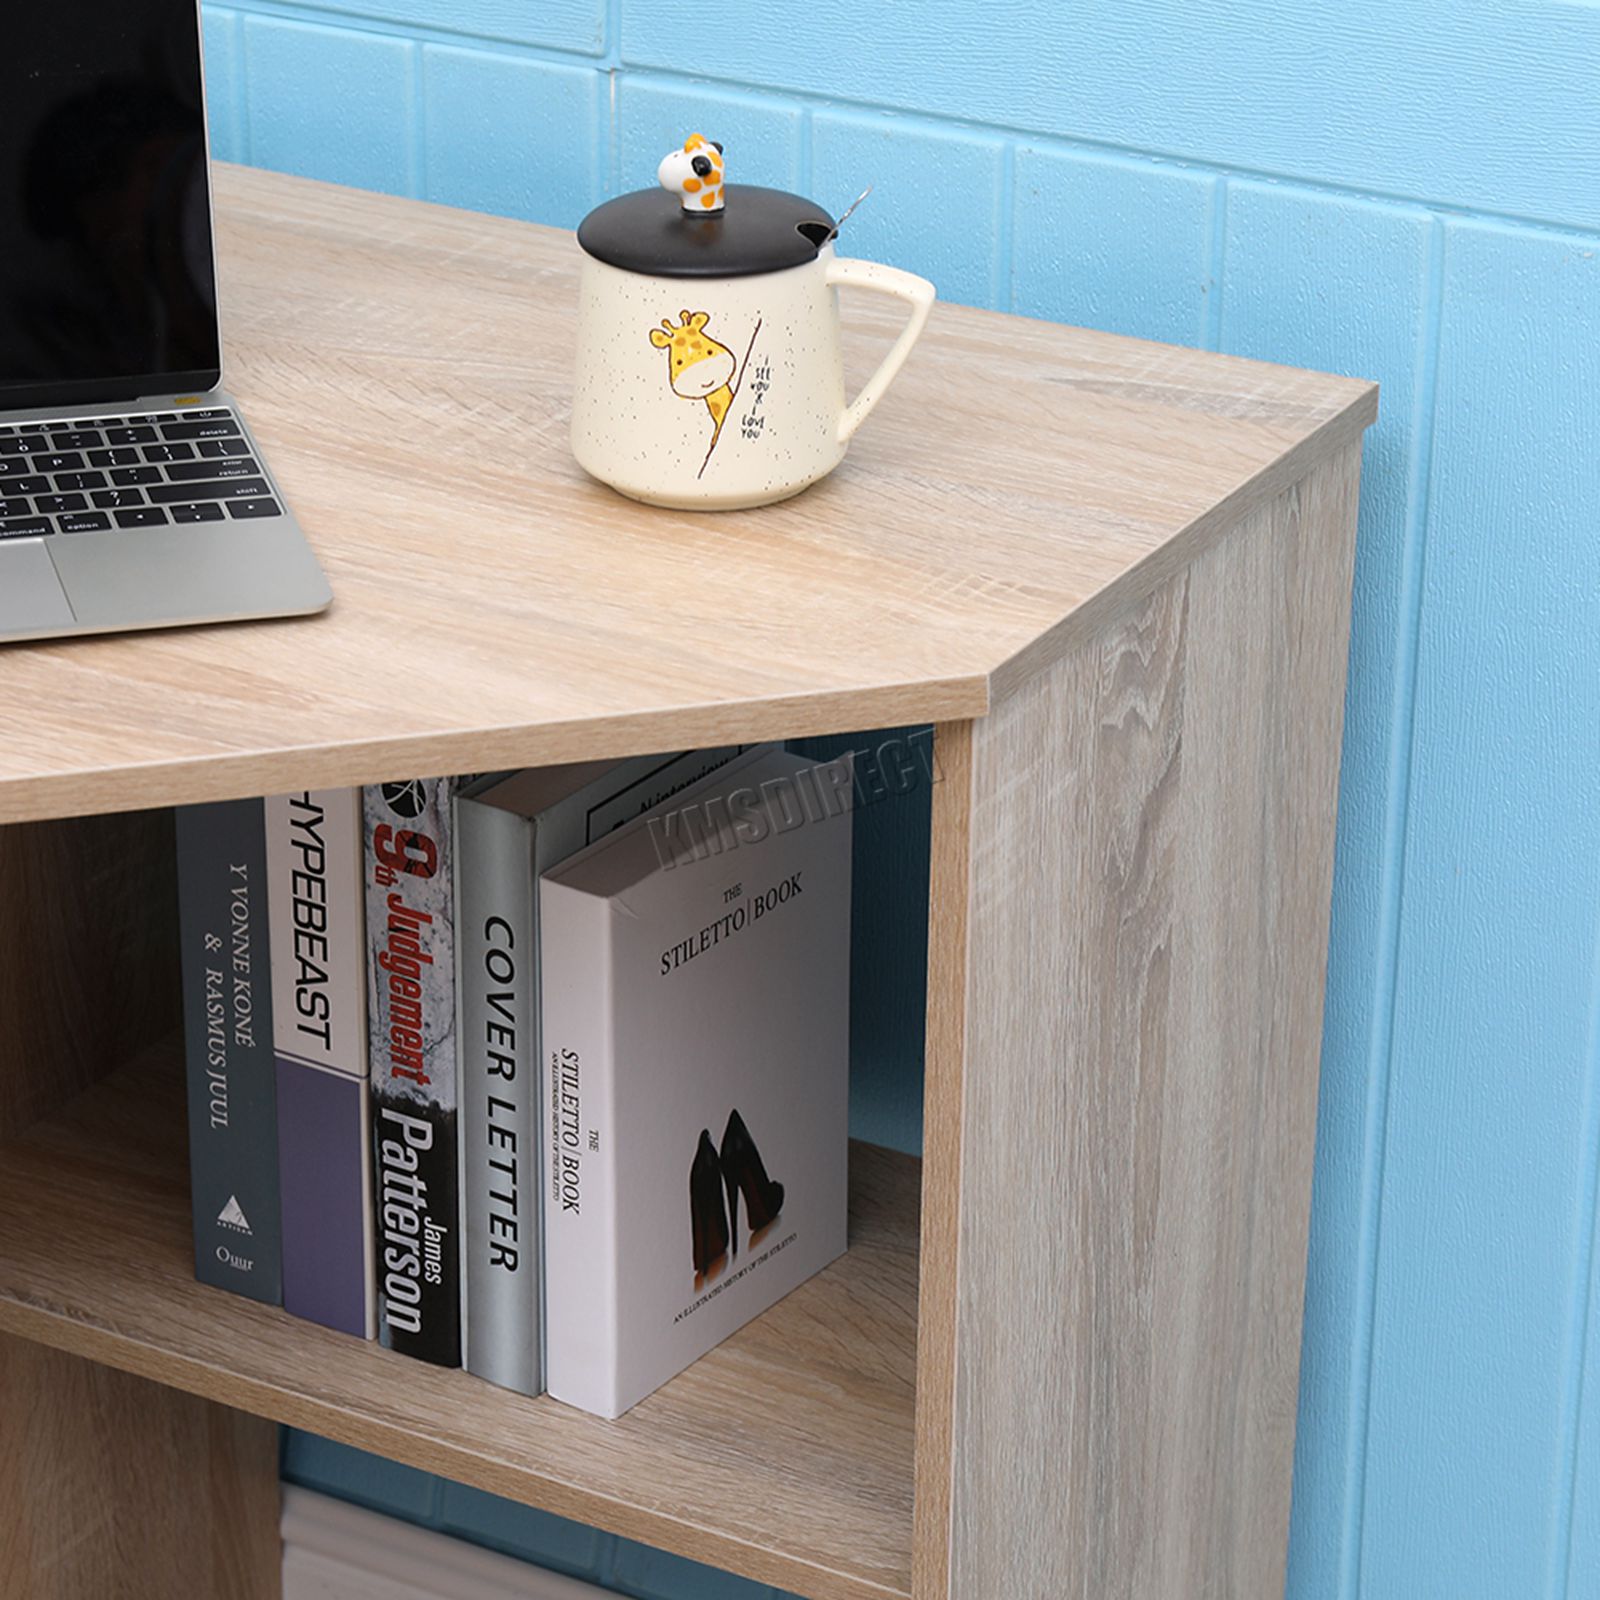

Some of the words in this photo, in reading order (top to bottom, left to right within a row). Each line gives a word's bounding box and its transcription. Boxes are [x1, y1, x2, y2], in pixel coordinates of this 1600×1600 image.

[741, 428, 760, 439] YOU
[742, 414, 765, 429] LOVE
[660, 907, 746, 976] STILETTO
[753, 871, 804, 921] BOOK
[723, 882, 743, 903] THE
[204, 932, 223, 952] &
[205, 968, 228, 1068] RASMUS
[379, 892, 434, 1086] Judgement
[484, 915, 516, 1081] COVER
[206, 1069, 229, 1129] JUUL
[561, 1047, 581, 1148] STILETTO
[589, 1128, 600, 1152] THE
[487, 1096, 519, 1273] LETTER
[562, 1155, 581, 1215] BOOK
[381, 1107, 434, 1334] Patterson
[424, 1216, 448, 1285] James
